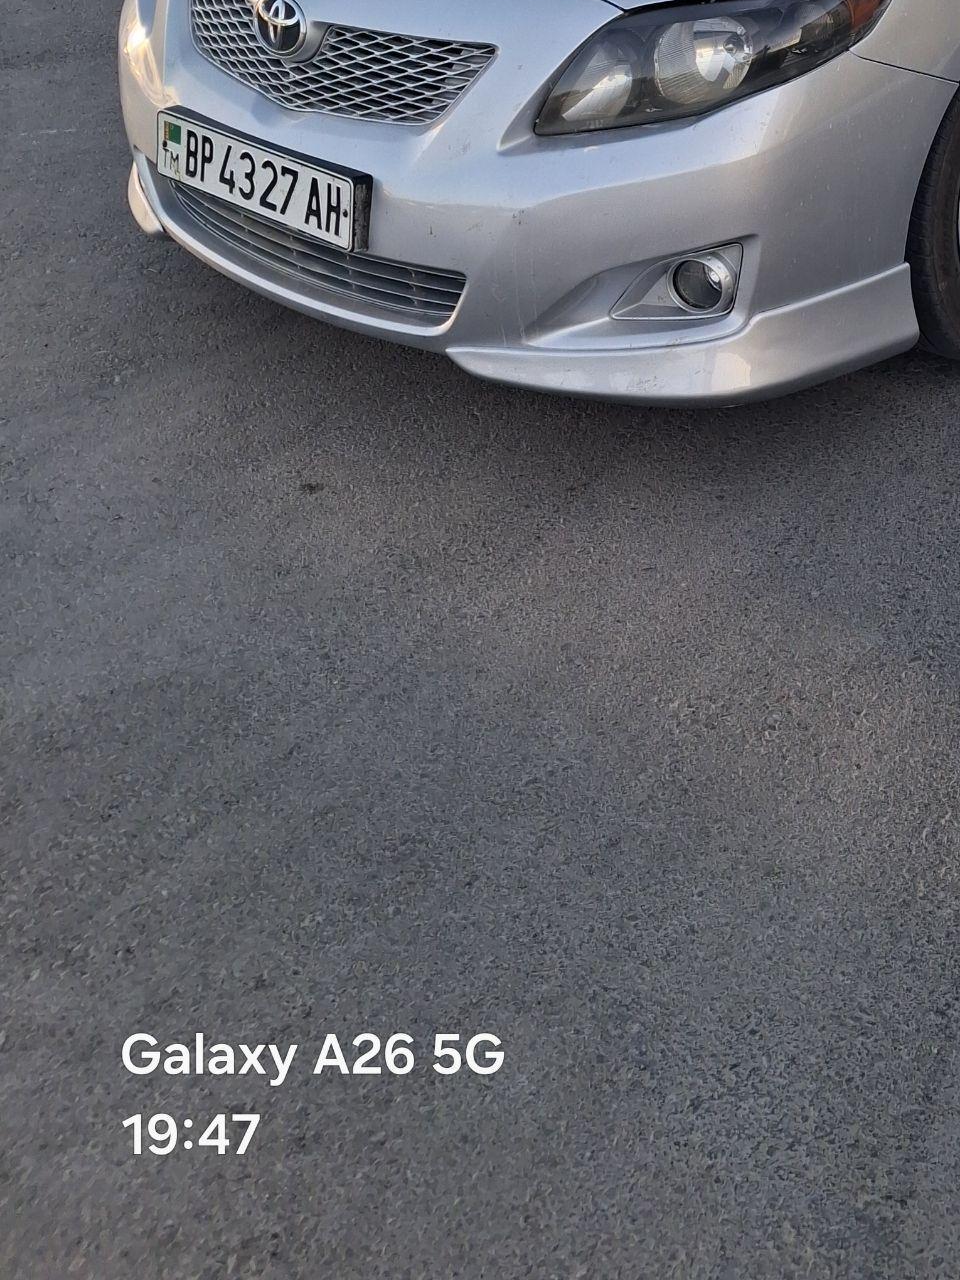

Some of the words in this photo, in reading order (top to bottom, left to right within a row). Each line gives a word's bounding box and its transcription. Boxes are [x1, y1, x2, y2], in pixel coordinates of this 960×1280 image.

[162, 147, 180, 172] TM
[185, 129, 214, 182] BP
[219, 145, 299, 215] 4327
[304, 177, 342, 237] AH
